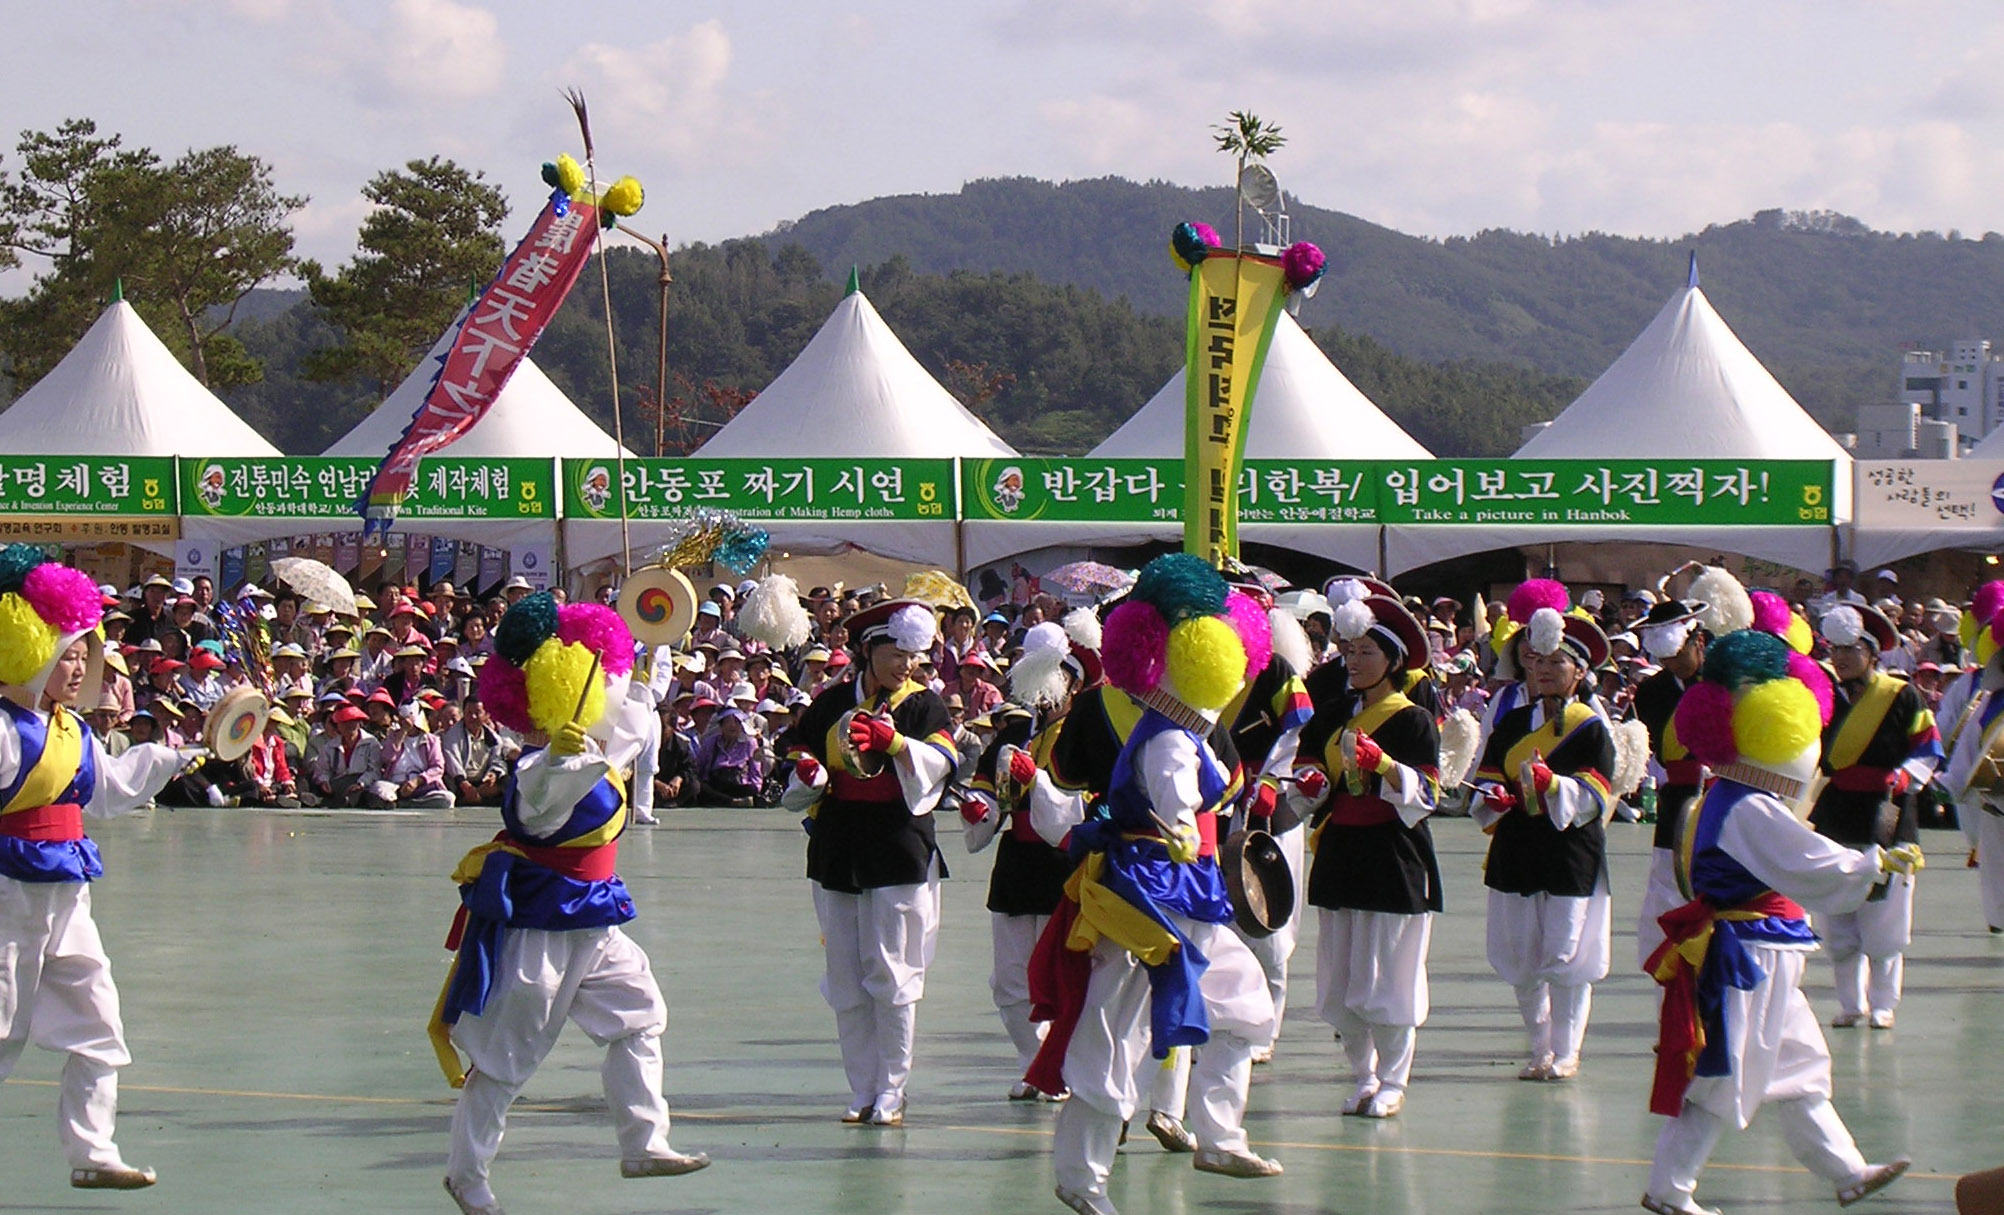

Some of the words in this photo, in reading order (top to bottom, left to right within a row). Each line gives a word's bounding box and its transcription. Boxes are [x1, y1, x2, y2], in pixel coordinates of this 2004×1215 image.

[230, 464, 311, 500] 전통민속
[428, 465, 509, 501] 제작체험
[622, 466, 731, 503] 안동포
[742, 466, 814, 504] 짜기
[829, 466, 905, 504] 시연
[1868, 467, 1915, 487] 성공한
[1041, 466, 1166, 504] 반갑다
[1385, 468, 1560, 506] 입어보고
[1572, 467, 1769, 506] 사진찍자!
[56, 501, 94, 512] Experience
[95, 501, 119, 511] Center
[416, 504, 465, 516] Traditional
[468, 504, 488, 516] Kite
[775, 507, 786, 517] of
[790, 507, 828, 519] Making
[832, 507, 862, 519] Hemp
[864, 507, 895, 517] cloths
[1412, 508, 1452, 520] Take
[1459, 511, 1469, 520] a
[1476, 508, 1535, 522] picture
[1542, 508, 1559, 520] in
[1566, 508, 1631, 521] Hanbok
